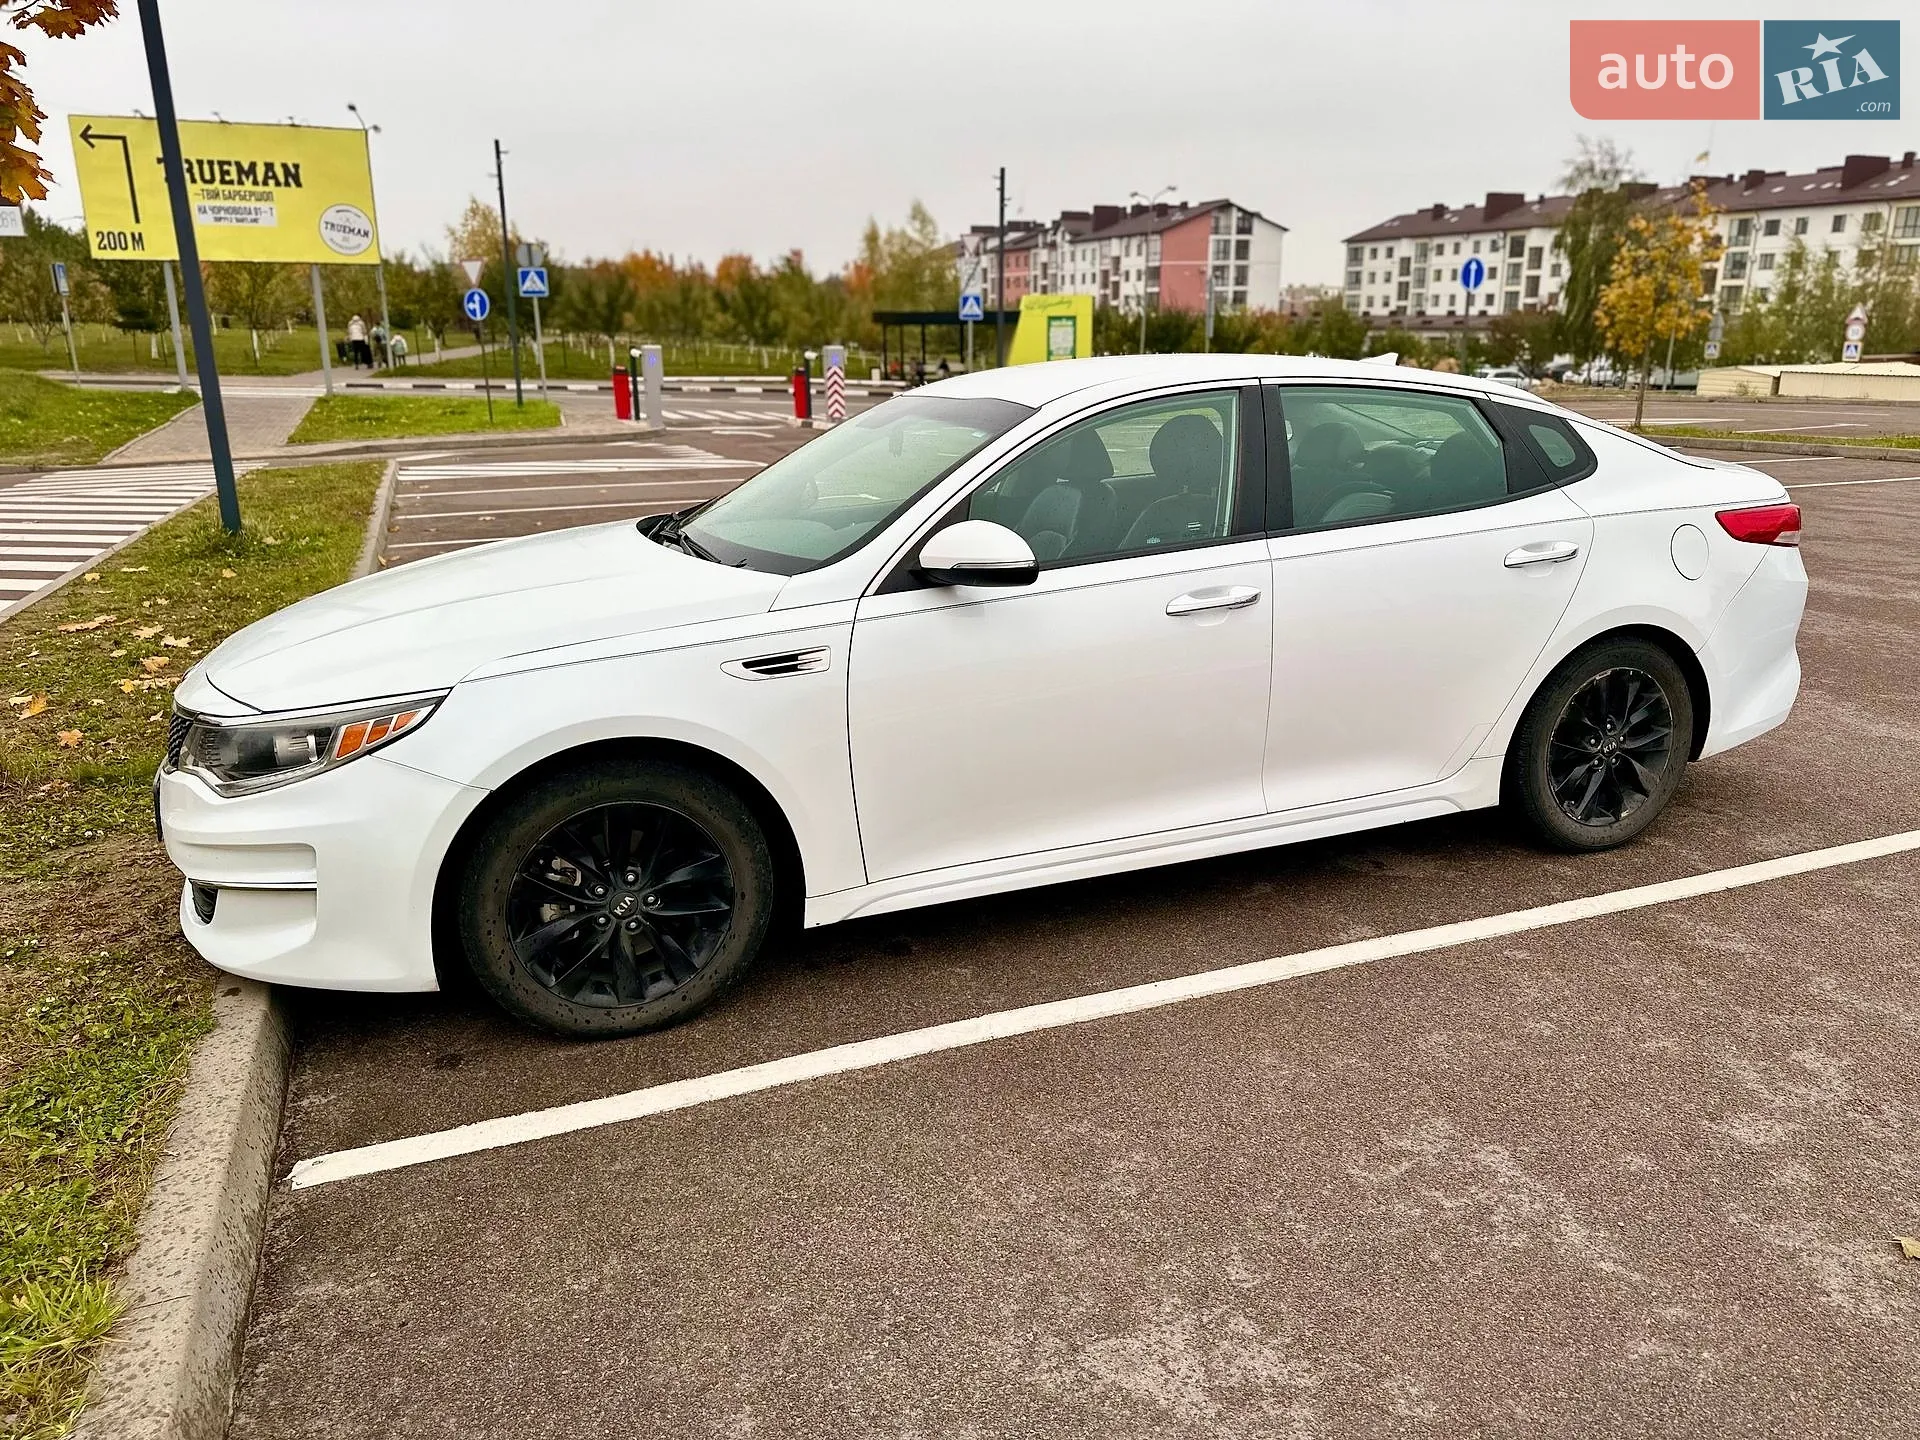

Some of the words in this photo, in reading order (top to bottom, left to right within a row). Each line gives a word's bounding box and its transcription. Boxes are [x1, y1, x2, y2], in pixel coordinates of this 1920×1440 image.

[156, 157, 302, 188] RUEMAN
[324, 220, 370, 239] TRUEMAN
[96, 231, 128, 251] 200
[1603, 741, 1617, 753] KIA
[614, 896, 635, 916] KIA
